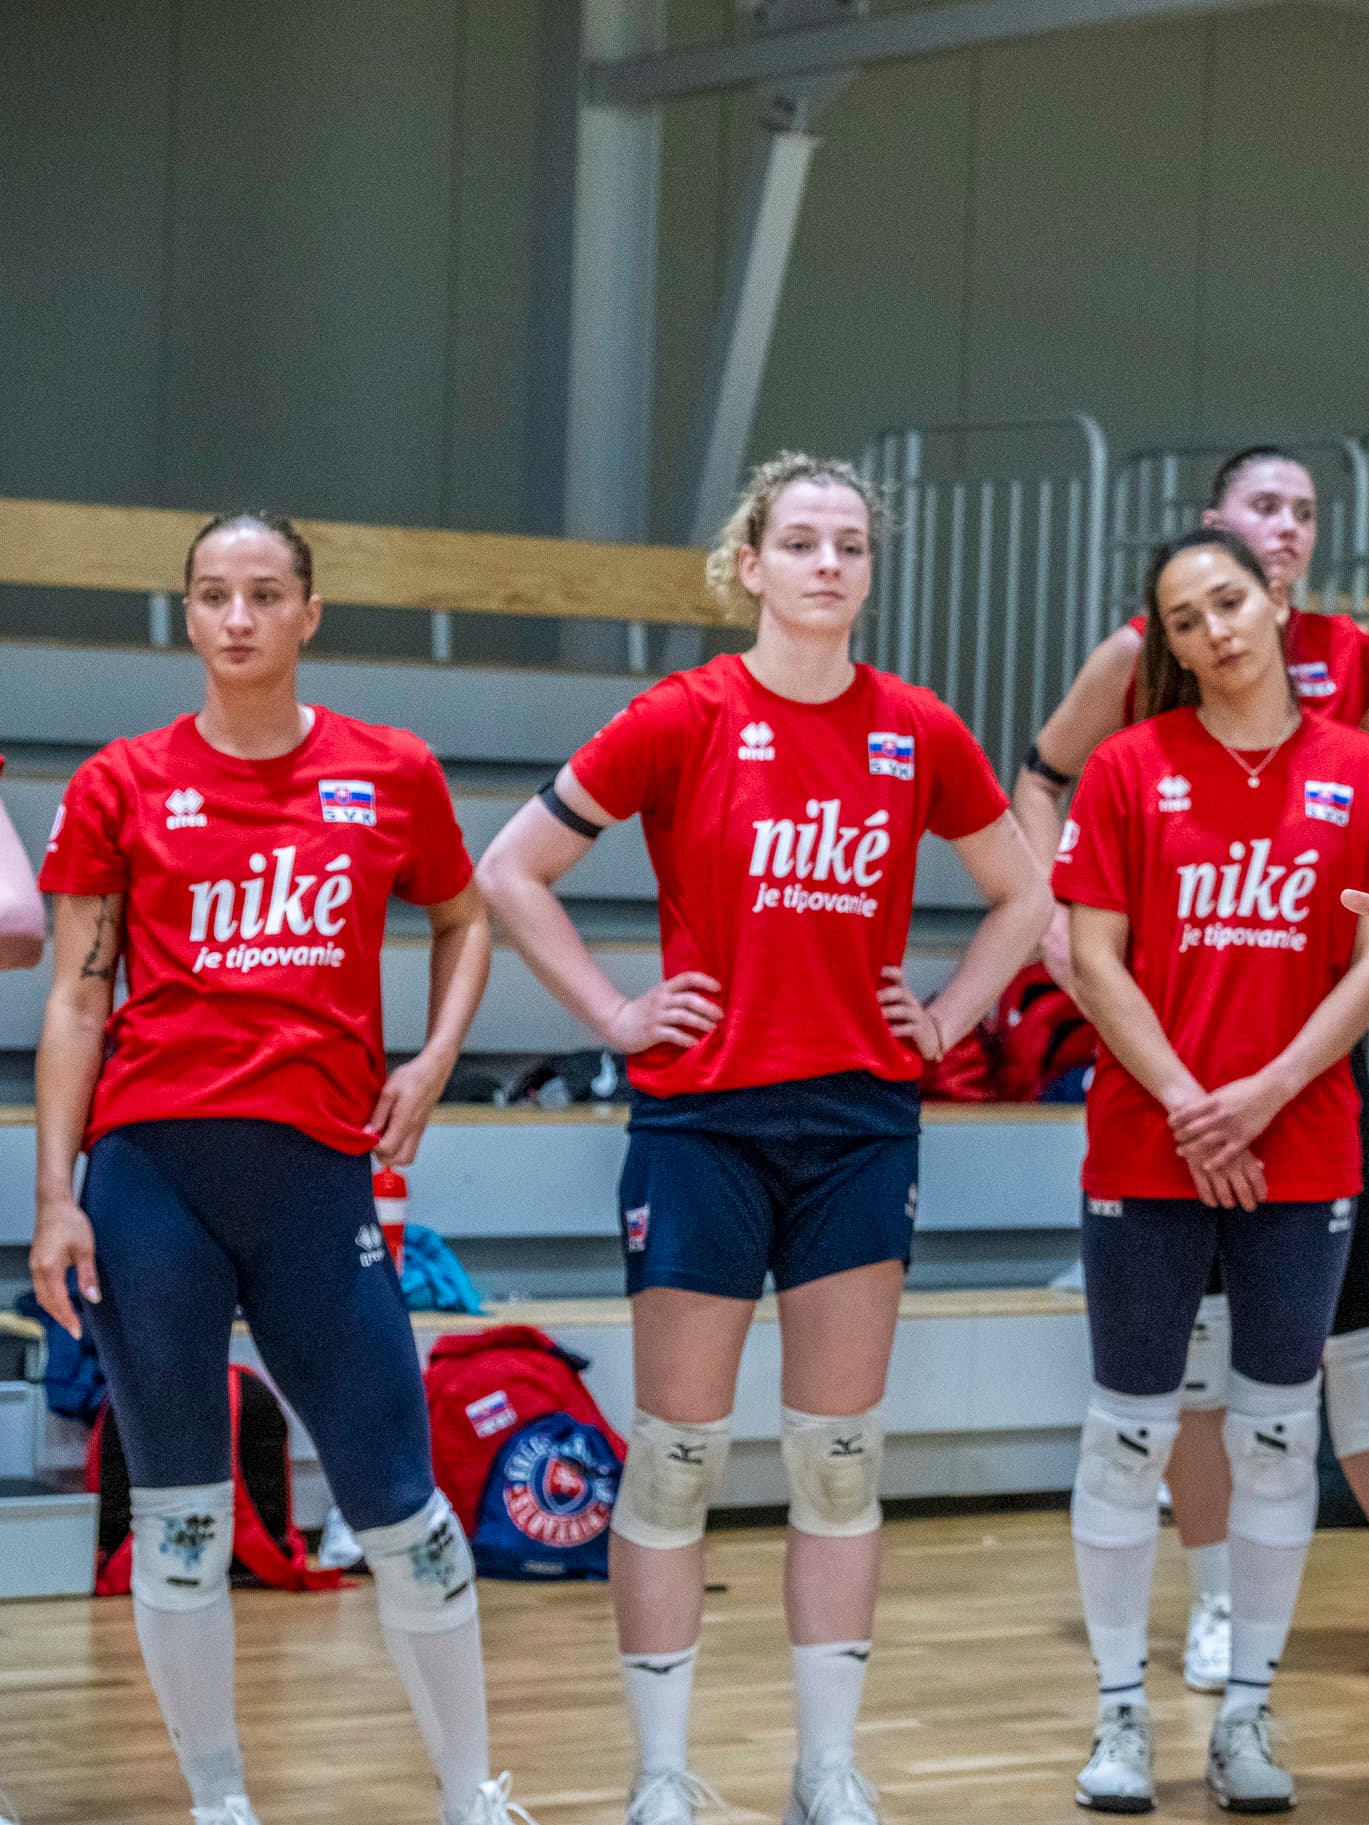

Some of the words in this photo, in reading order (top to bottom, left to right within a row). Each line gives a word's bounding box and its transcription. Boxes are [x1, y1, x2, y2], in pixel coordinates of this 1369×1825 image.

[748, 798, 891, 888] niké
[188, 844, 353, 943] niké
[752, 882, 781, 913] je
[783, 883, 878, 918] tipovanie
[1177, 838, 1320, 923] niké
[192, 946, 223, 974] je
[225, 941, 346, 973] tipovanie
[1178, 923, 1201, 953] je
[1203, 921, 1308, 952] tipovanie
